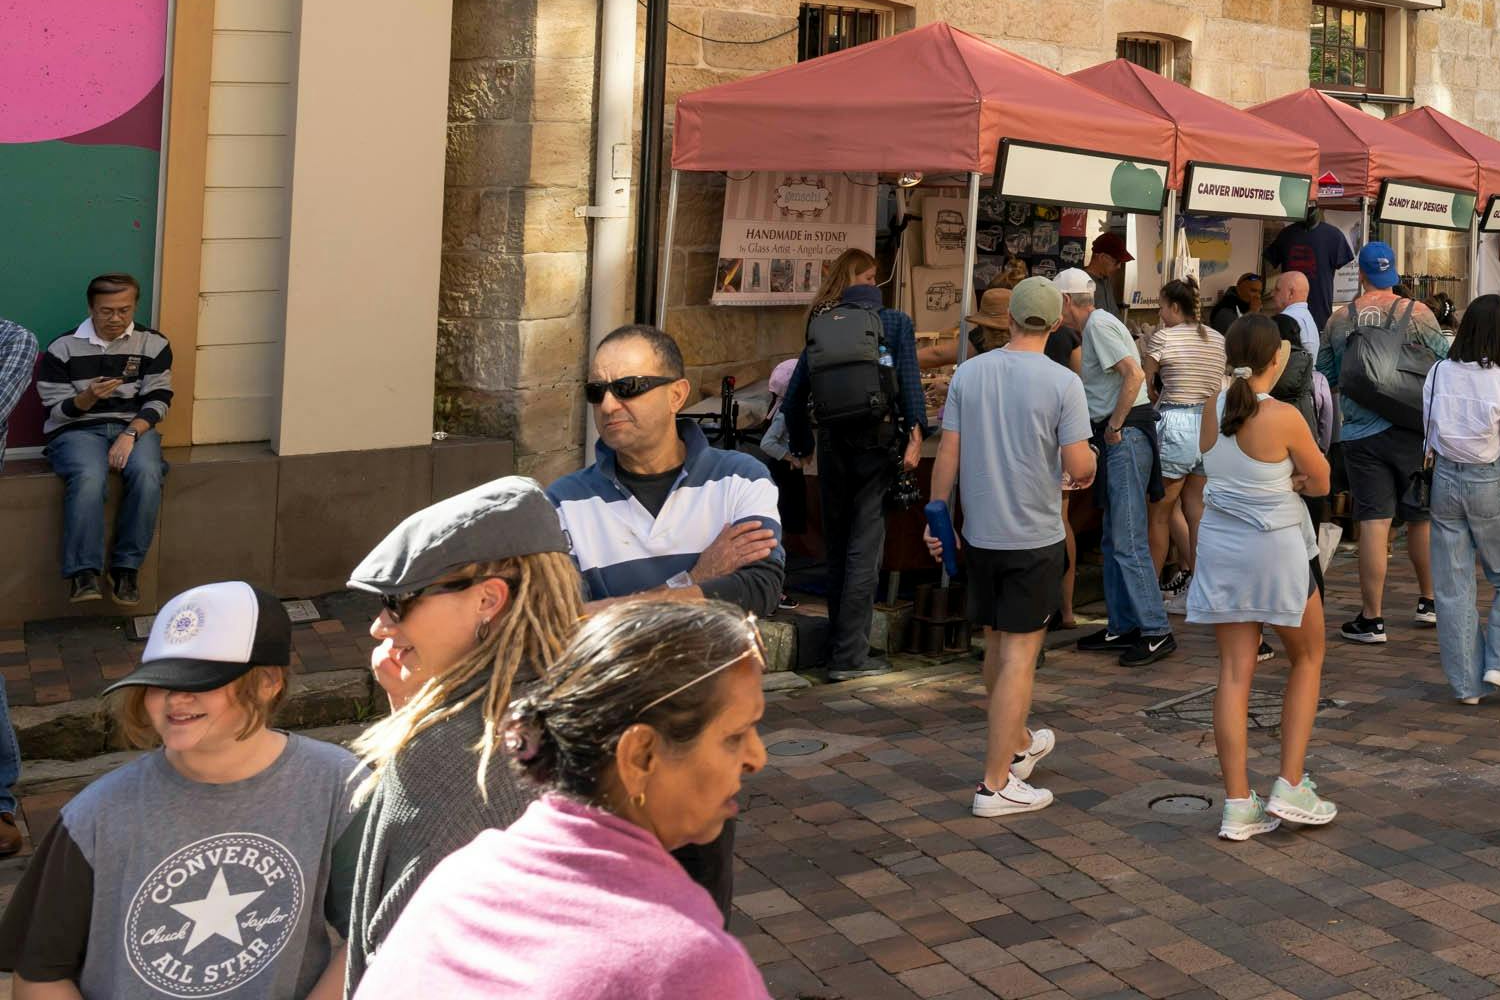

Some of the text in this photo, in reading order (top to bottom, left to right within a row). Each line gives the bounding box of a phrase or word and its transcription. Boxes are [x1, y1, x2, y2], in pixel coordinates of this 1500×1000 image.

[1198, 183, 1275, 201] CARVER INDUSTRIES
[1388, 197, 1448, 214] SANDY BAY DESIGNS
[746, 229, 848, 242] HANDMADE in SYDNEY
[747, 242, 770, 254] Glass
[797, 244, 823, 257] Angela
[151, 846, 286, 904] CONVERSE
[140, 907, 288, 946] Chuck Taylor
[151, 938, 269, 984] ALL STAR
